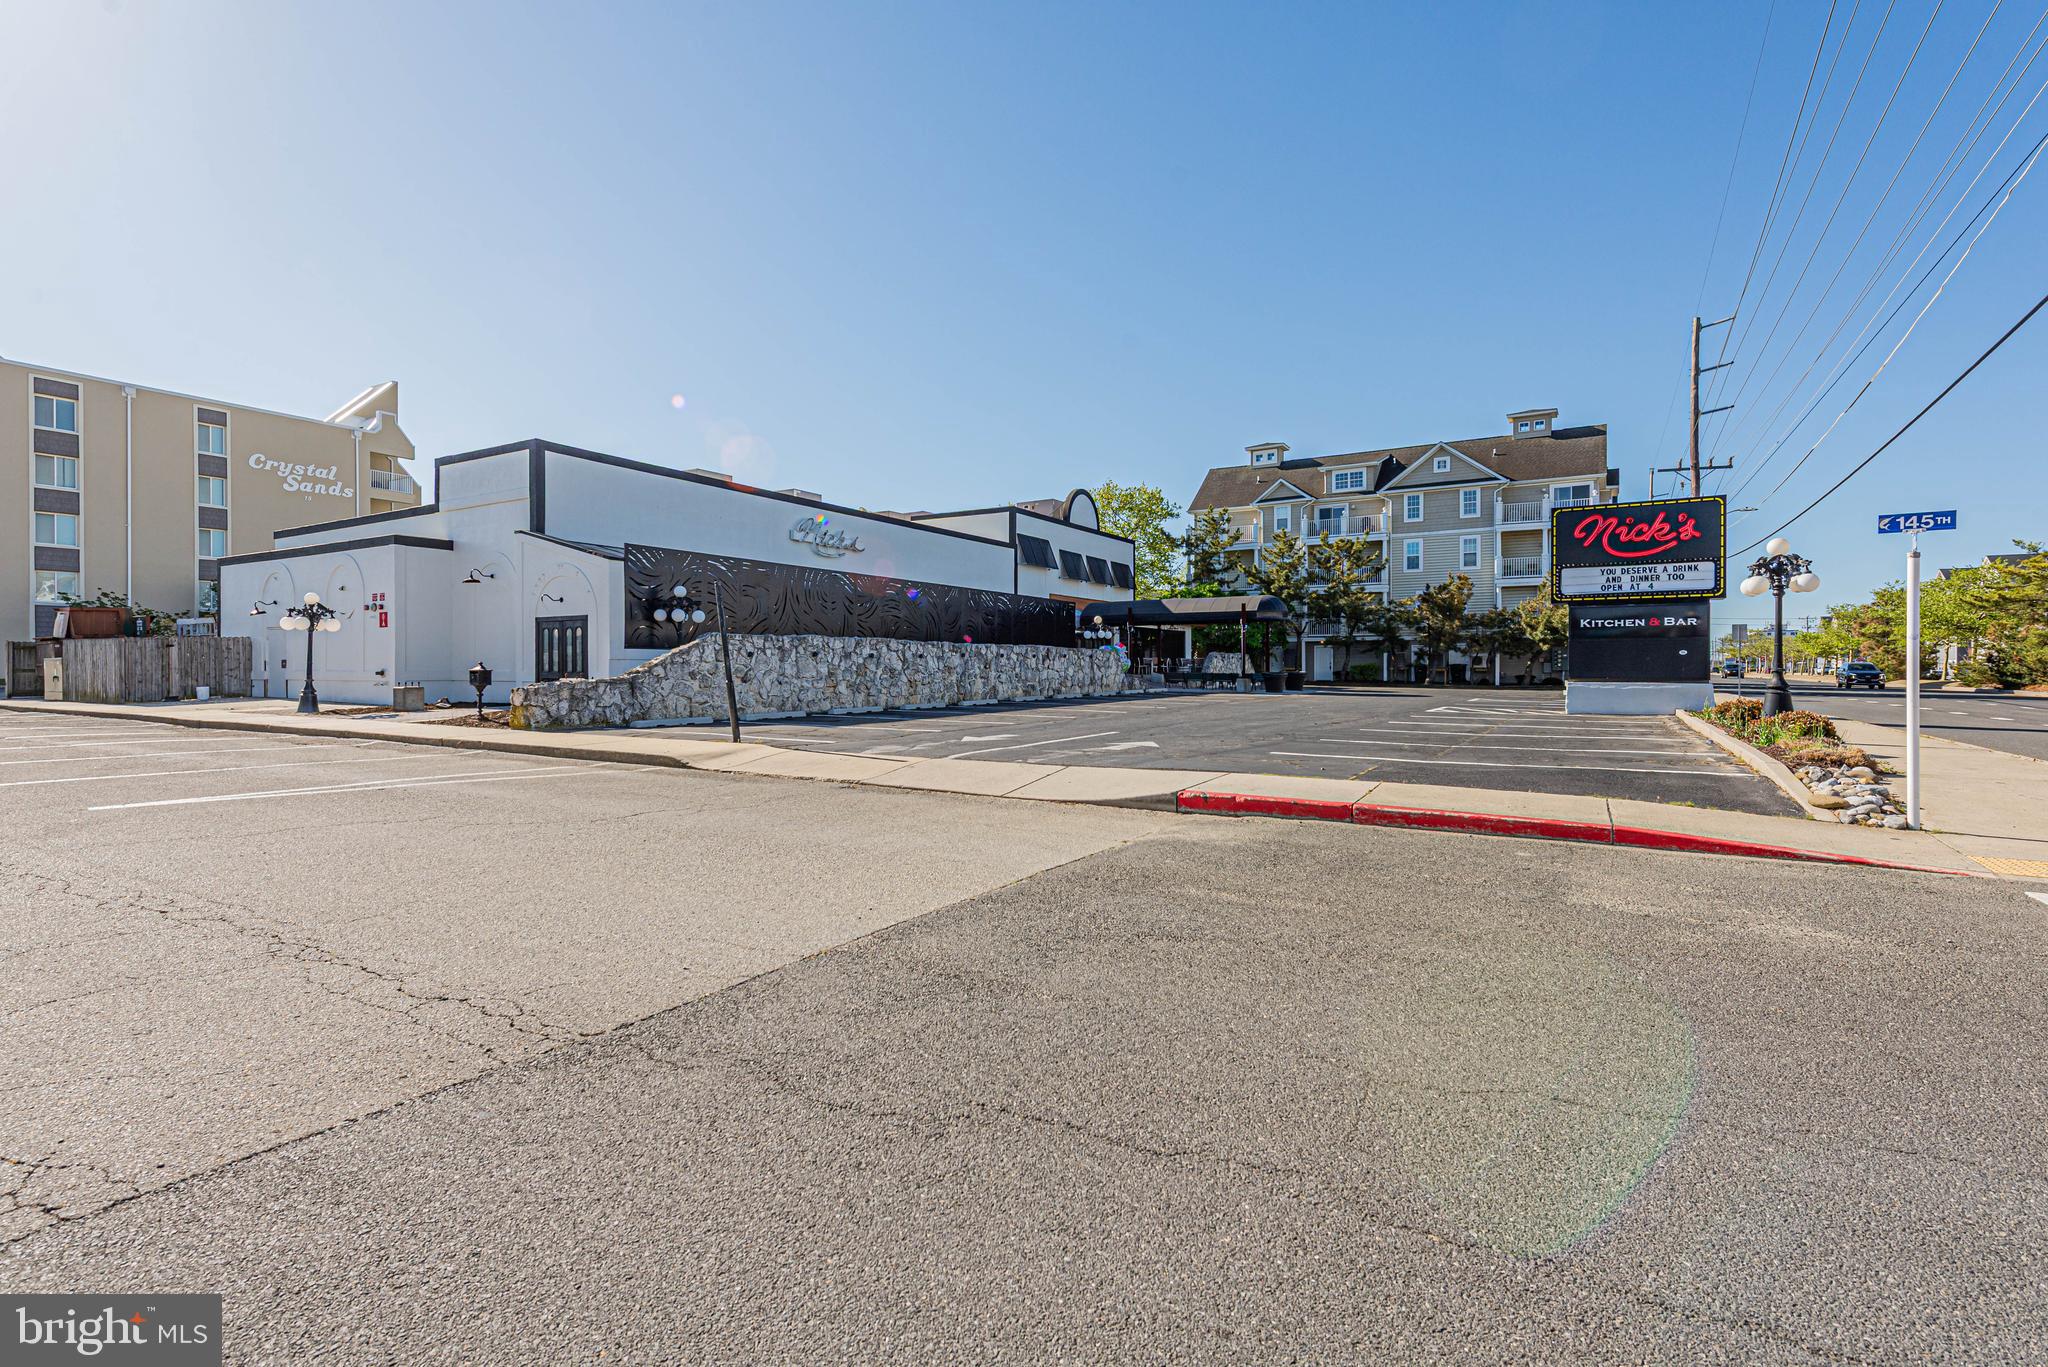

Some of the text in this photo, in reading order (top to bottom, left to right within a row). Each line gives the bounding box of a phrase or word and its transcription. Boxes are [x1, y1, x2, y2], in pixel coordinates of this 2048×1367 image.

[248, 453, 337, 480] Crystal
[283, 475, 354, 497] Sands
[1574, 511, 1702, 558] Nick's
[1600, 564, 1699, 576] YOU DESERVE A DRINK
[1630, 574, 1661, 582] DINNER
[1667, 573, 1685, 581] TOO
[1600, 582, 1654, 592] OPEN AT 4
[1580, 617, 1698, 628] KITCHEN & BAR
